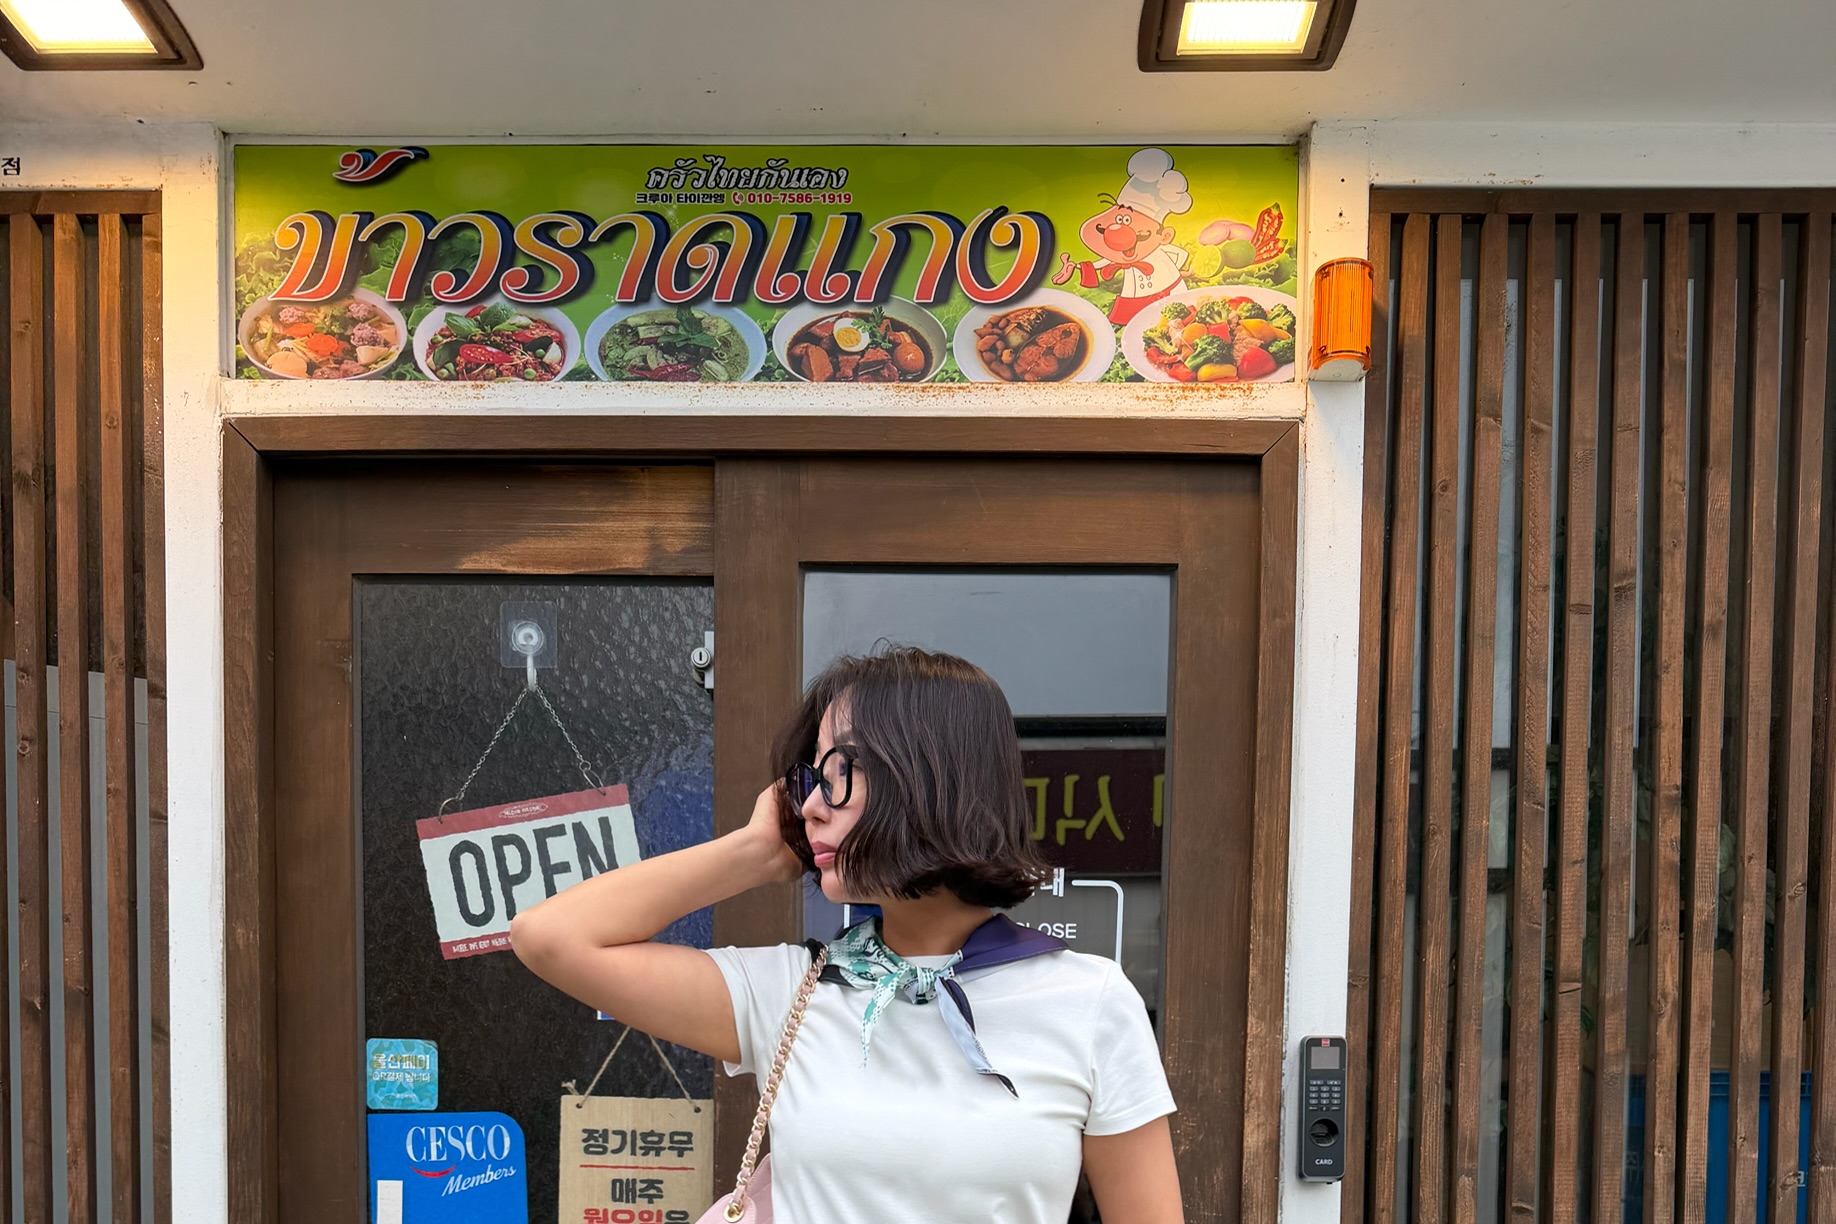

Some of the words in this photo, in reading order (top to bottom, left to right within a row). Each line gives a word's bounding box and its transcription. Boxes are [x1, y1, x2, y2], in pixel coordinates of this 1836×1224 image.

[636, 192, 673, 204] 크루아
[747, 192, 852, 204] 010-7586-1919
[406, 1123, 511, 1163] CESCO
[581, 1128, 694, 1158] 정기휴무
[1315, 1158, 1333, 1166] CARD
[441, 1164, 517, 1197] Members
[611, 1178, 664, 1204] 매주
